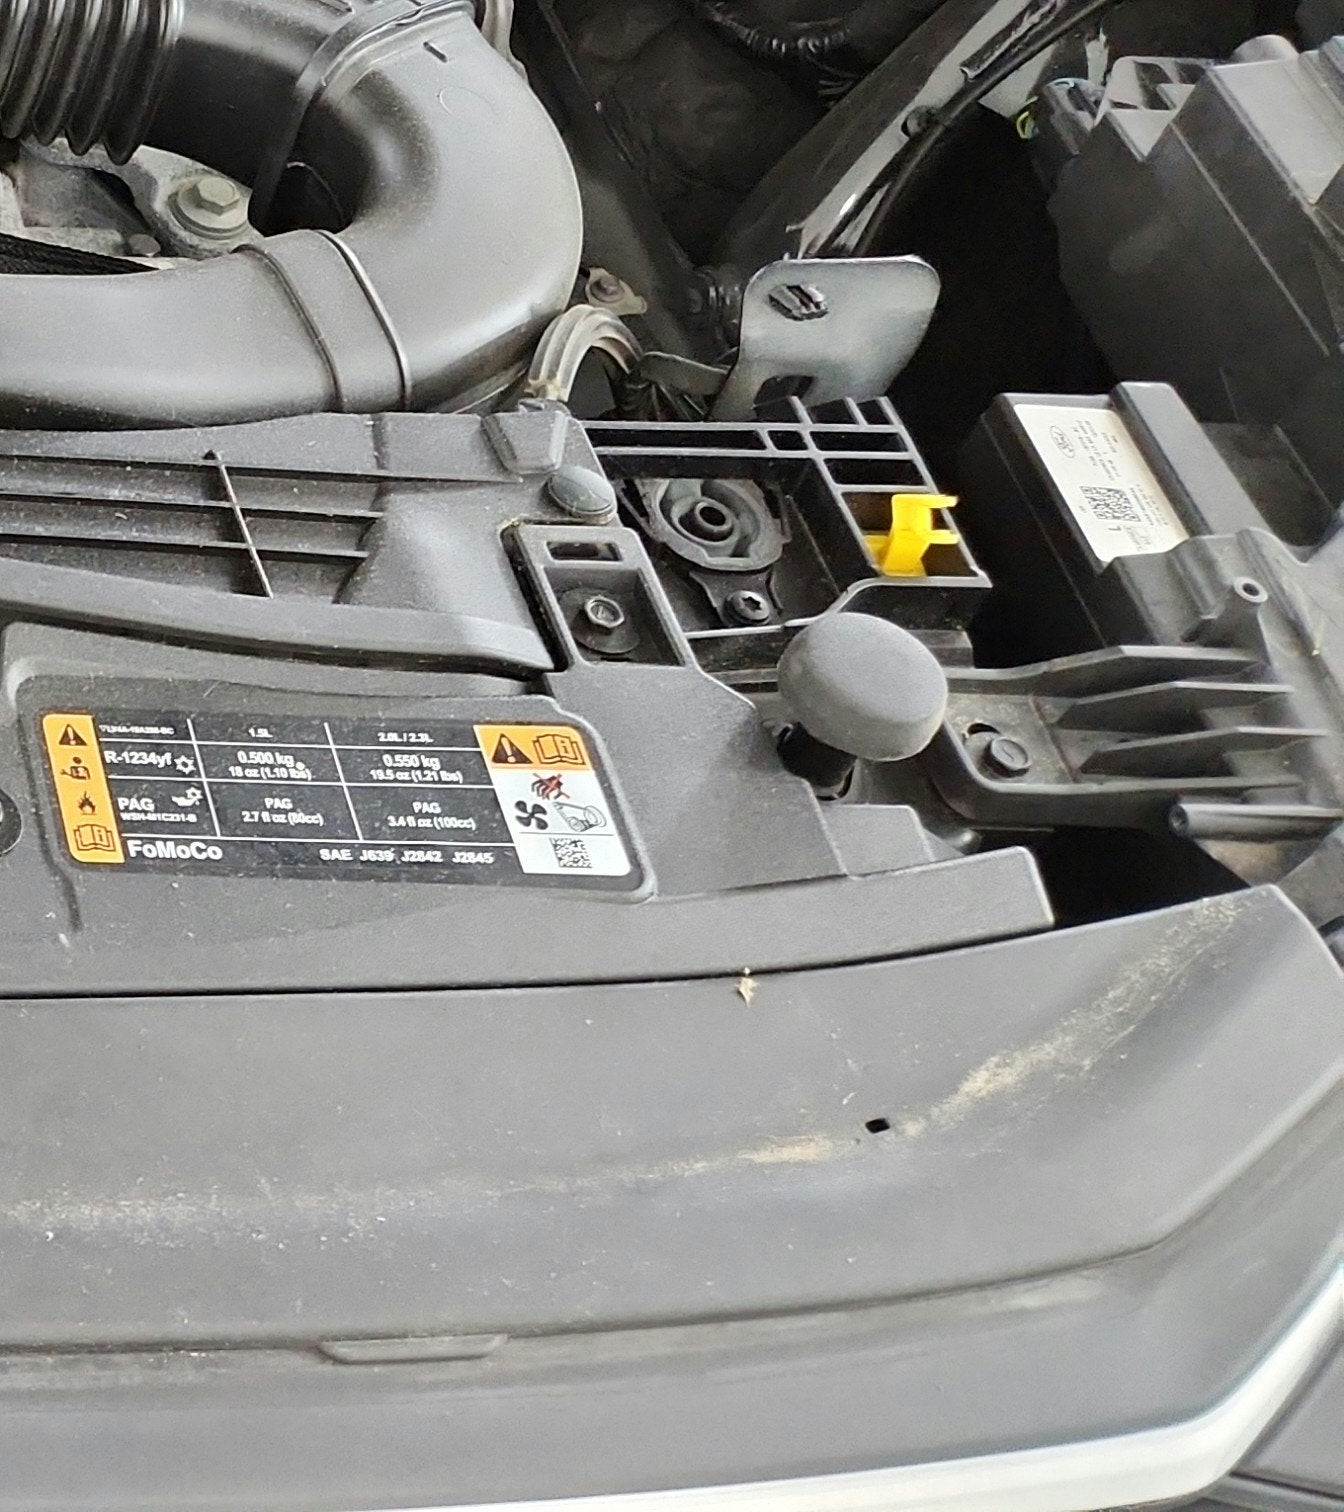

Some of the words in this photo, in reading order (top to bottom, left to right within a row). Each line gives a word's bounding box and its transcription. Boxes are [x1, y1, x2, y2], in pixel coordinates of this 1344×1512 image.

[104, 750, 172, 768] R-1234yf
[237, 750, 273, 764] 0.500
[275, 752, 295, 768] kg
[382, 753, 419, 768] 0.550
[421, 754, 441, 770] kg
[229, 765, 244, 777] 18
[244, 768, 260, 777] oz
[260, 766, 288, 779] (1.10
[370, 769, 395, 781] 19.5
[395, 771, 411, 780] oz
[412, 769, 439, 783] (1.21
[440, 770, 463, 784] lbs)
[117, 796, 155, 812] PAG
[264, 797, 293, 809] PAG
[412, 801, 442, 814] PAG
[242, 810, 260, 822] 2.7
[261, 810, 271, 823] fl
[272, 813, 288, 823] oz
[387, 815, 406, 827] 3.4
[407, 815, 417, 827] fl
[418, 817, 433, 828] oz
[433, 816, 476, 831] (100cc)
[126, 839, 223, 860] FoMoCo
[319, 848, 353, 861] SAE
[360, 848, 394, 862] J639
[401, 850, 443, 863] J2842
[452, 851, 494, 865] J2845
